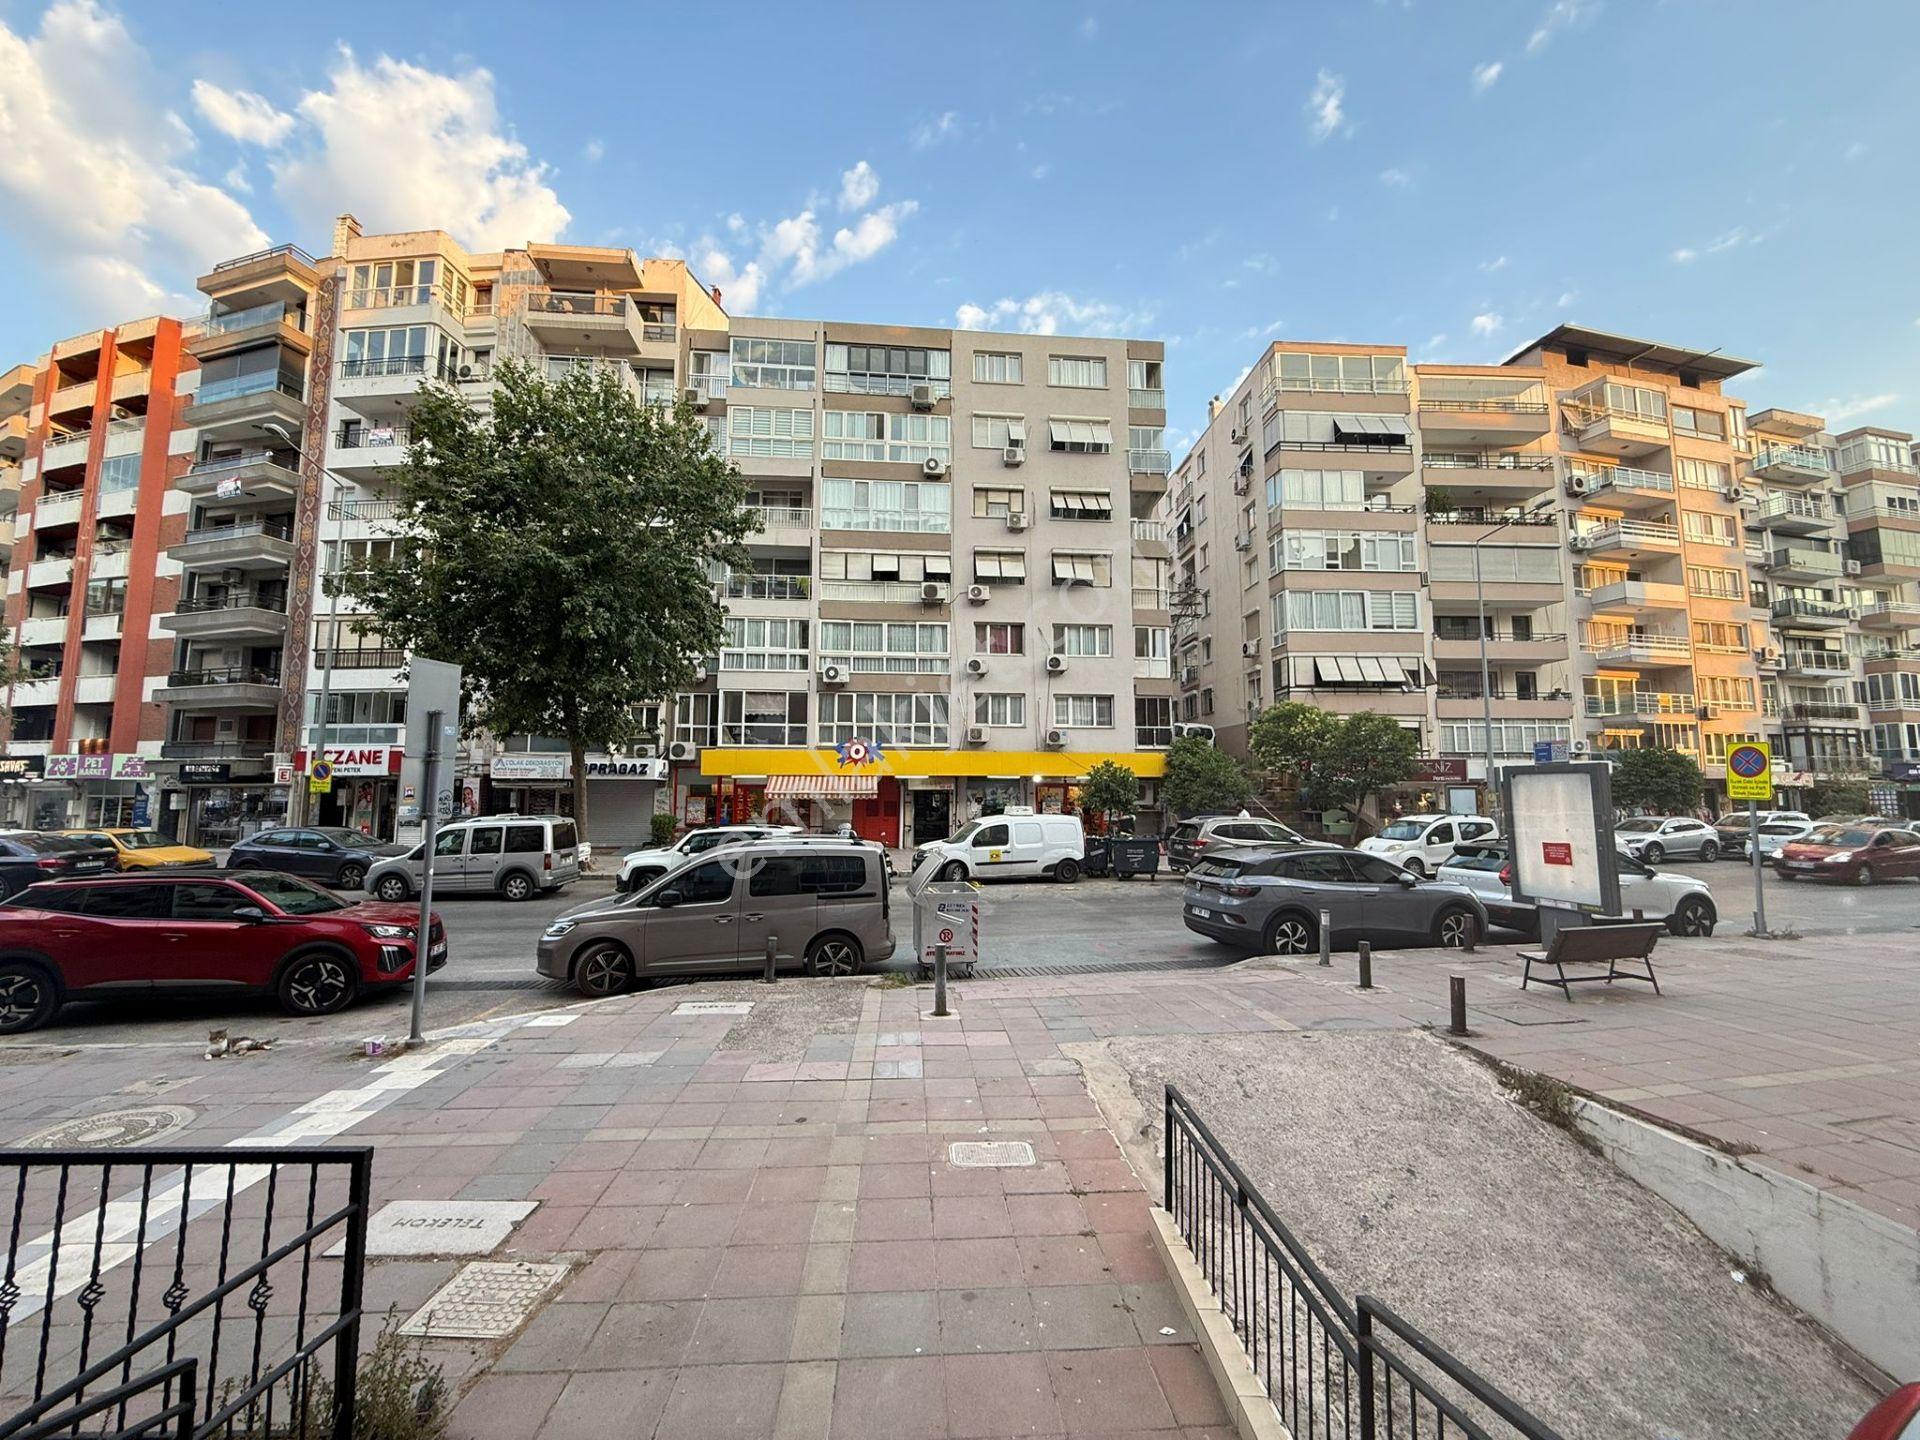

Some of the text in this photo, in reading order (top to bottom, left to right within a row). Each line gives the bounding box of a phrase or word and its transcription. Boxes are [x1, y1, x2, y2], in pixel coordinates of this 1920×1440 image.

[84, 757, 104, 768] PET
[280, 771, 288, 780] E
[391, 1218, 485, 1229] TELEKOM
